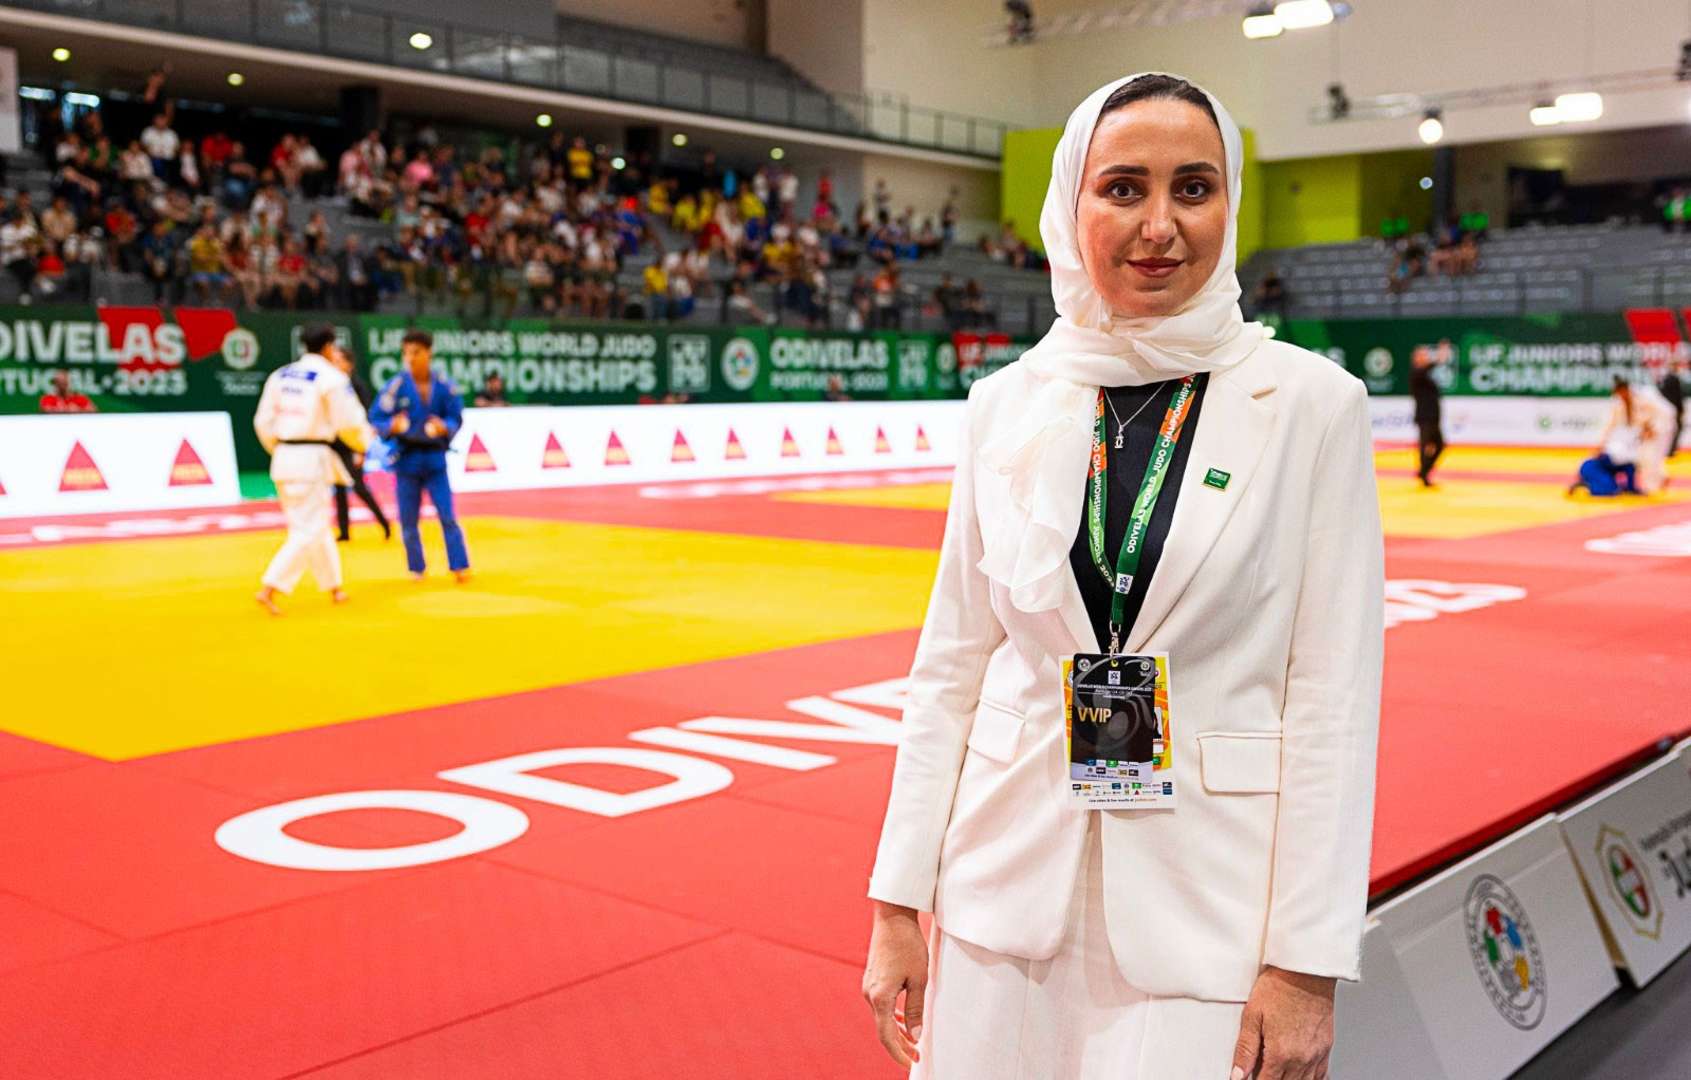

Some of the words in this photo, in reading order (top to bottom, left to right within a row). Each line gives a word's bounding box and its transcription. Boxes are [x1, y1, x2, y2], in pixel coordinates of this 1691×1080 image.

[432, 329, 513, 356] UNIORS
[518, 332, 598, 356] WORLD
[601, 334, 656, 357] JUDO
[769, 338, 889, 369] ODIVELAS
[370, 357, 656, 391] CAMPIONSHIPS
[1153, 449, 1167, 473] JUDO
[1161, 383, 1192, 447] CHAMPIONSHIPS
[1077, 707, 1112, 722] VVIP
